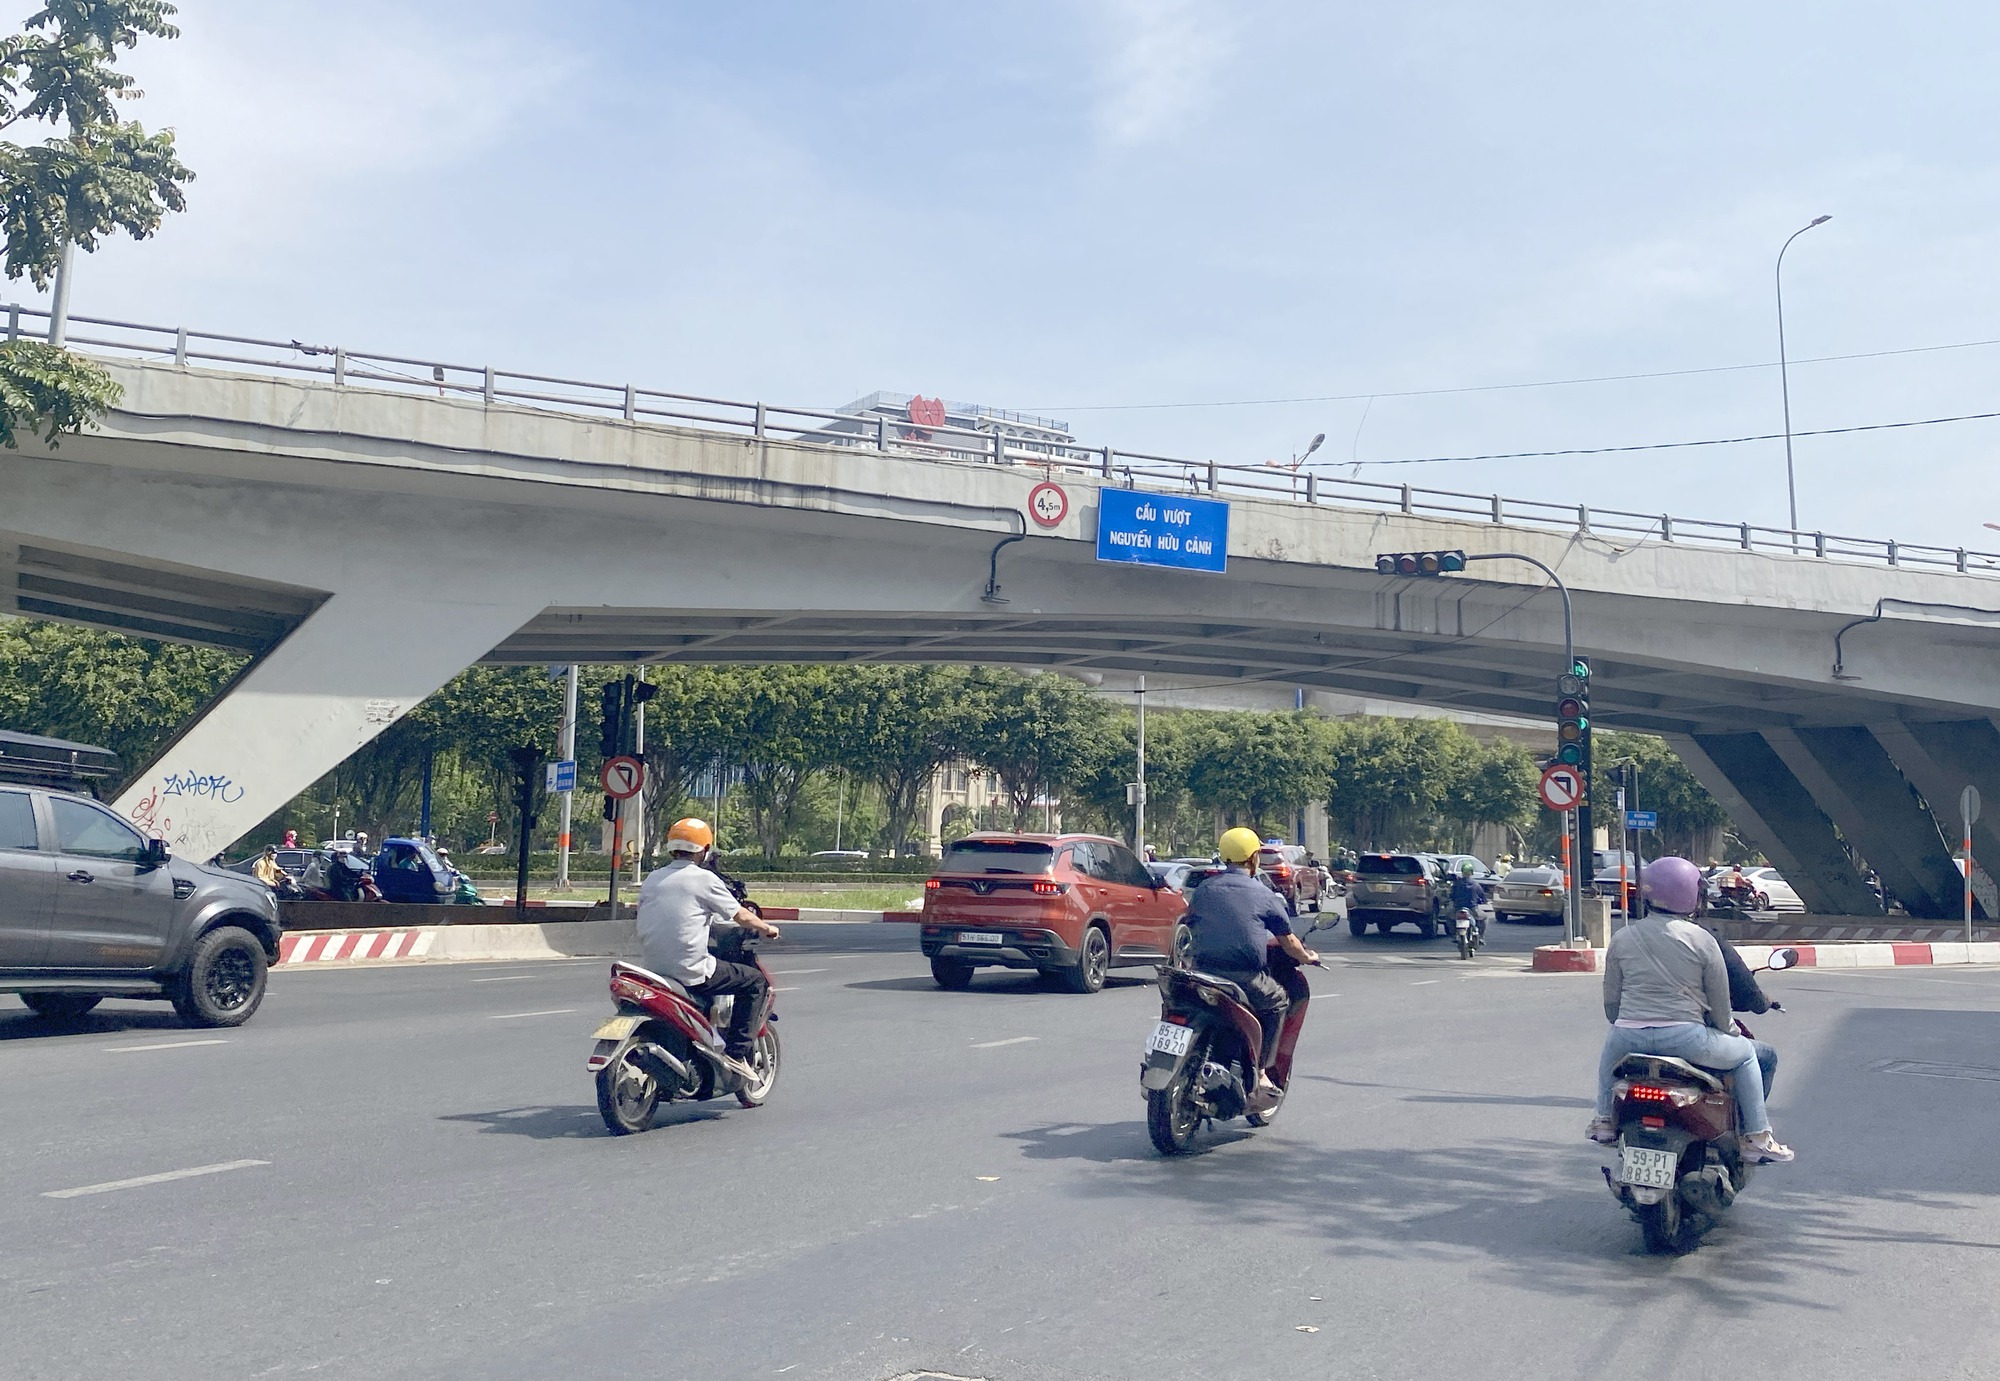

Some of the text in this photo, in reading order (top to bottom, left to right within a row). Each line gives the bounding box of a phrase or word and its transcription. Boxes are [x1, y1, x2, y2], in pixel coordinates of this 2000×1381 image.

[1135, 502, 1192, 527] CẦU VƯỢT
[1109, 529, 1213, 555] NGUYỄN HỮU CẢNH
[1158, 1024, 1186, 1041] 85-E1
[1632, 1150, 1667, 1169] 59-P1
